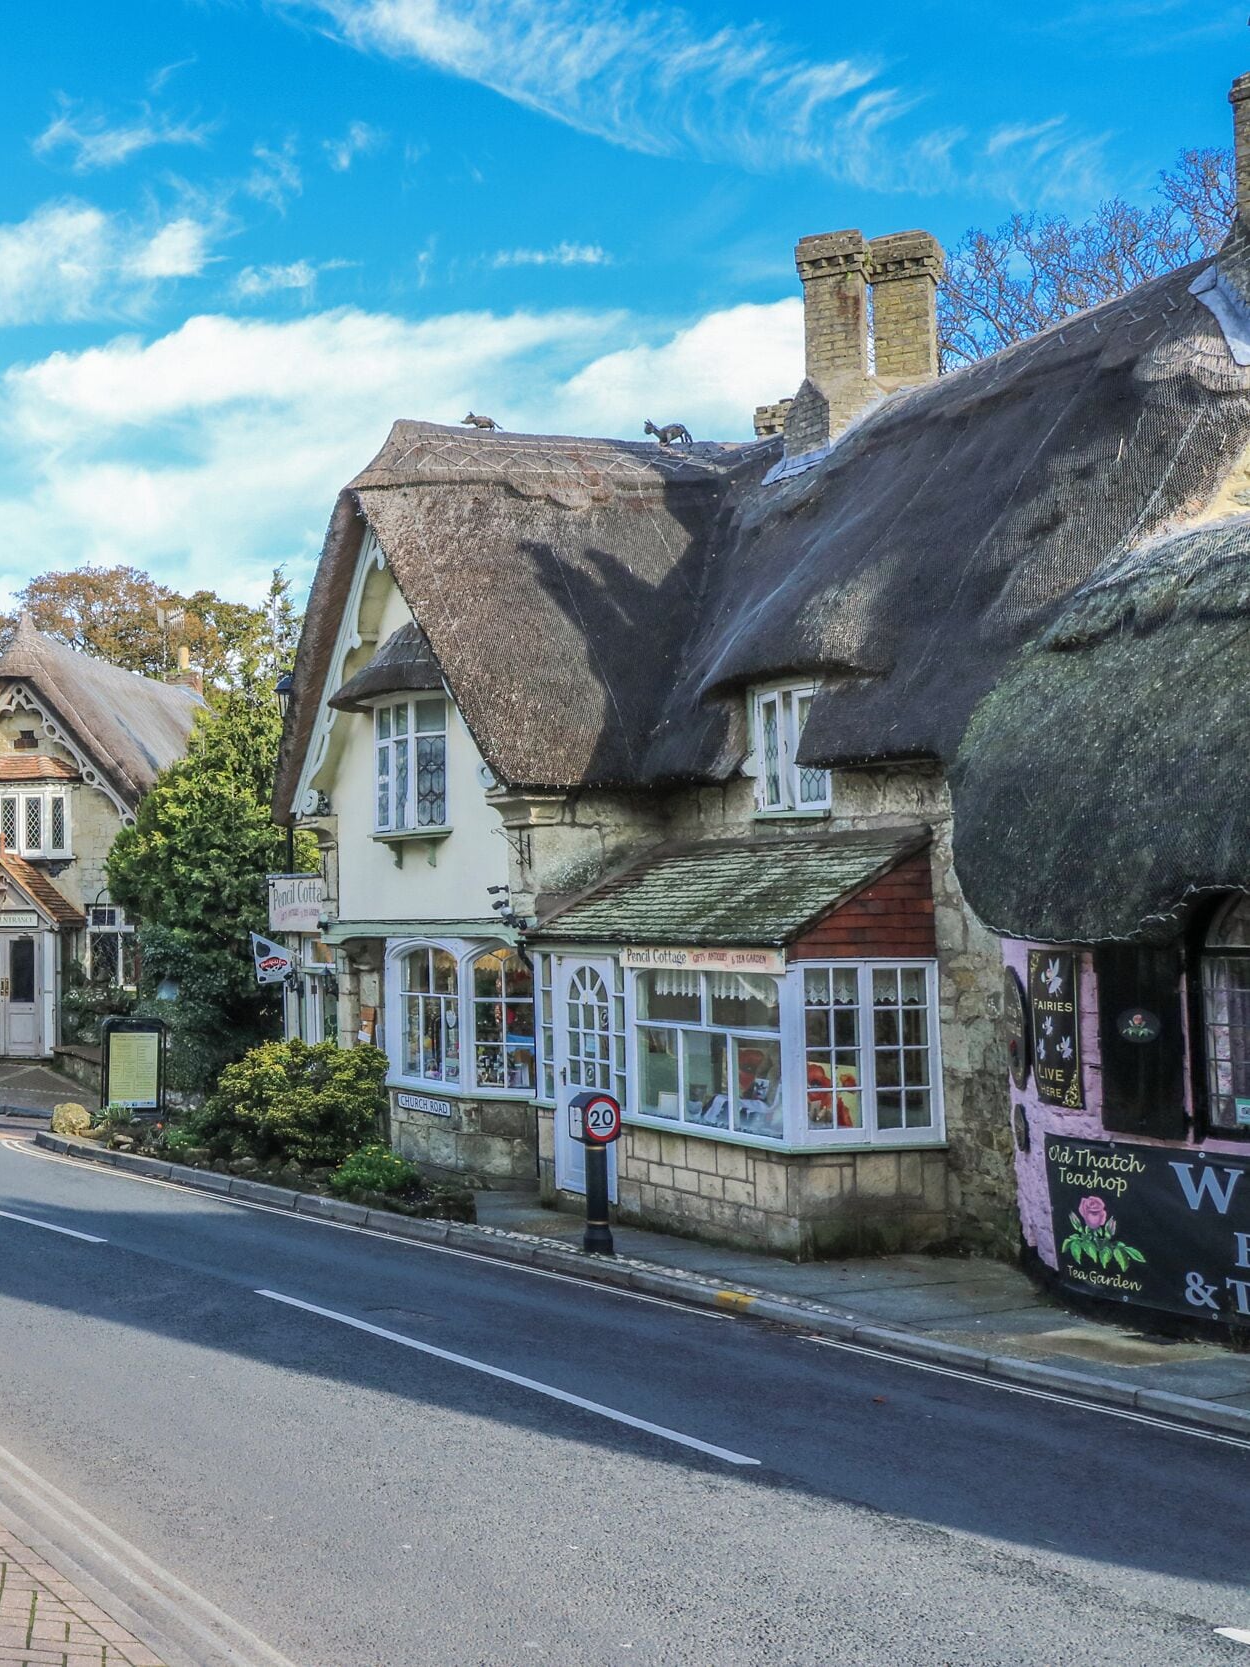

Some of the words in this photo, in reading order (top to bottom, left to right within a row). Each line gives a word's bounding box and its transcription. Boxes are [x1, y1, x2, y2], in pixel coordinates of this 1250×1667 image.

[273, 882, 295, 911] Pencil
[627, 948, 650, 963] Pencil
[653, 948, 687, 966] Cottage
[746, 954, 767, 965] GARDEN
[1034, 998, 1073, 1012] FAIRIES
[1038, 1064, 1064, 1082] LIVE
[1041, 1086, 1062, 1098] HERE
[400, 1095, 428, 1110] CHURCH
[429, 1100, 448, 1114] ROAD
[590, 1109, 614, 1127] 20
[1049, 1145, 1073, 1164] Old
[1076, 1149, 1146, 1173] Thatch
[1058, 1167, 1128, 1198] Teashop
[1066, 1265, 1088, 1281] Tea
[1089, 1270, 1143, 1292] Garden
[1185, 1271, 1221, 1310] &
